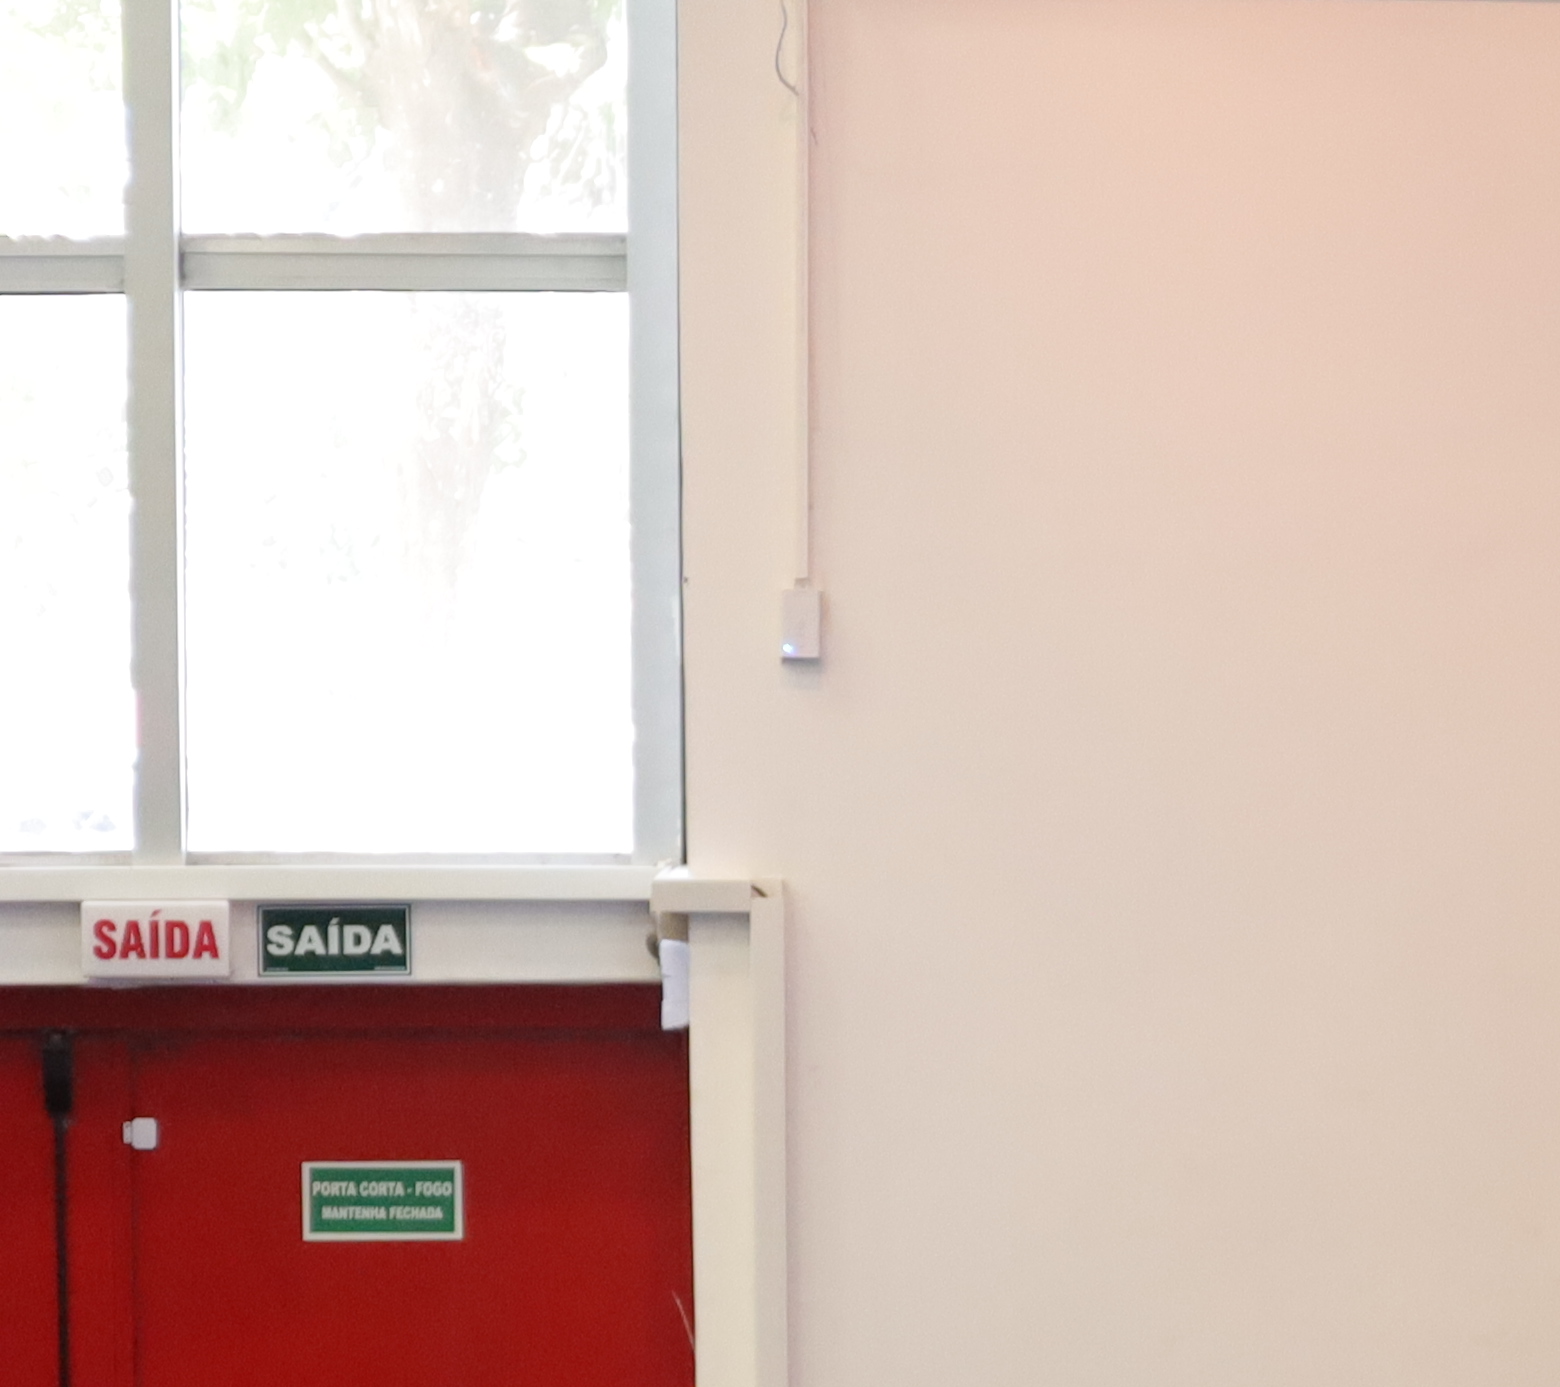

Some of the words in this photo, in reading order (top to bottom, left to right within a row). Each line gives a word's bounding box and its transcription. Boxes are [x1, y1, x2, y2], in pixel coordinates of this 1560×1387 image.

[92, 909, 220, 960] SAÍDA
[266, 917, 404, 957] SAÍDA
[312, 1181, 357, 1197] PORTA
[359, 1181, 405, 1197] CORTA
[414, 1181, 453, 1197] FOGO
[321, 1205, 387, 1220] MANTENHA
[389, 1206, 444, 1220] FECHADA
